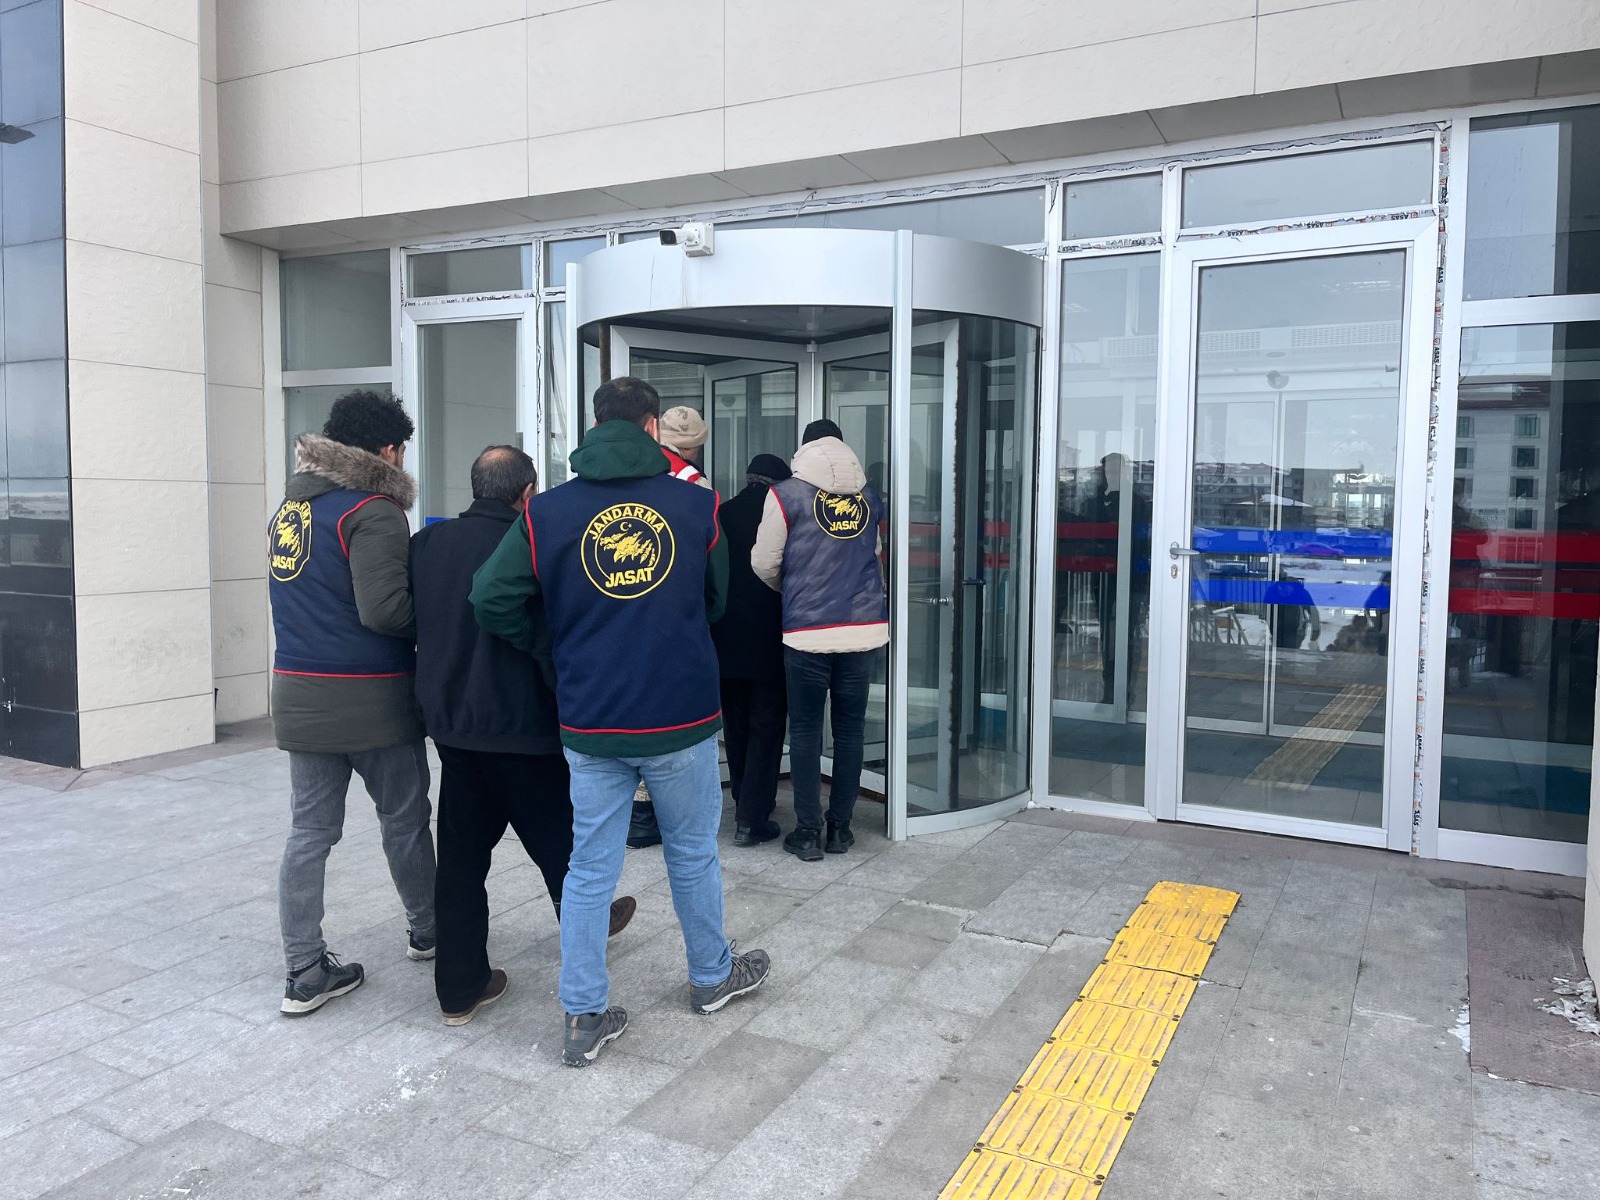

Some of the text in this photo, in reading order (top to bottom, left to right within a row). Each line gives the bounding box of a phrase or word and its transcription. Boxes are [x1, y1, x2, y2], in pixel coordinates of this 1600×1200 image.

[589, 506, 665, 540] JANDARMA
[831, 520, 859, 531] JASAT
[272, 555, 296, 570] JASAT
[605, 566, 655, 588] JASAT
